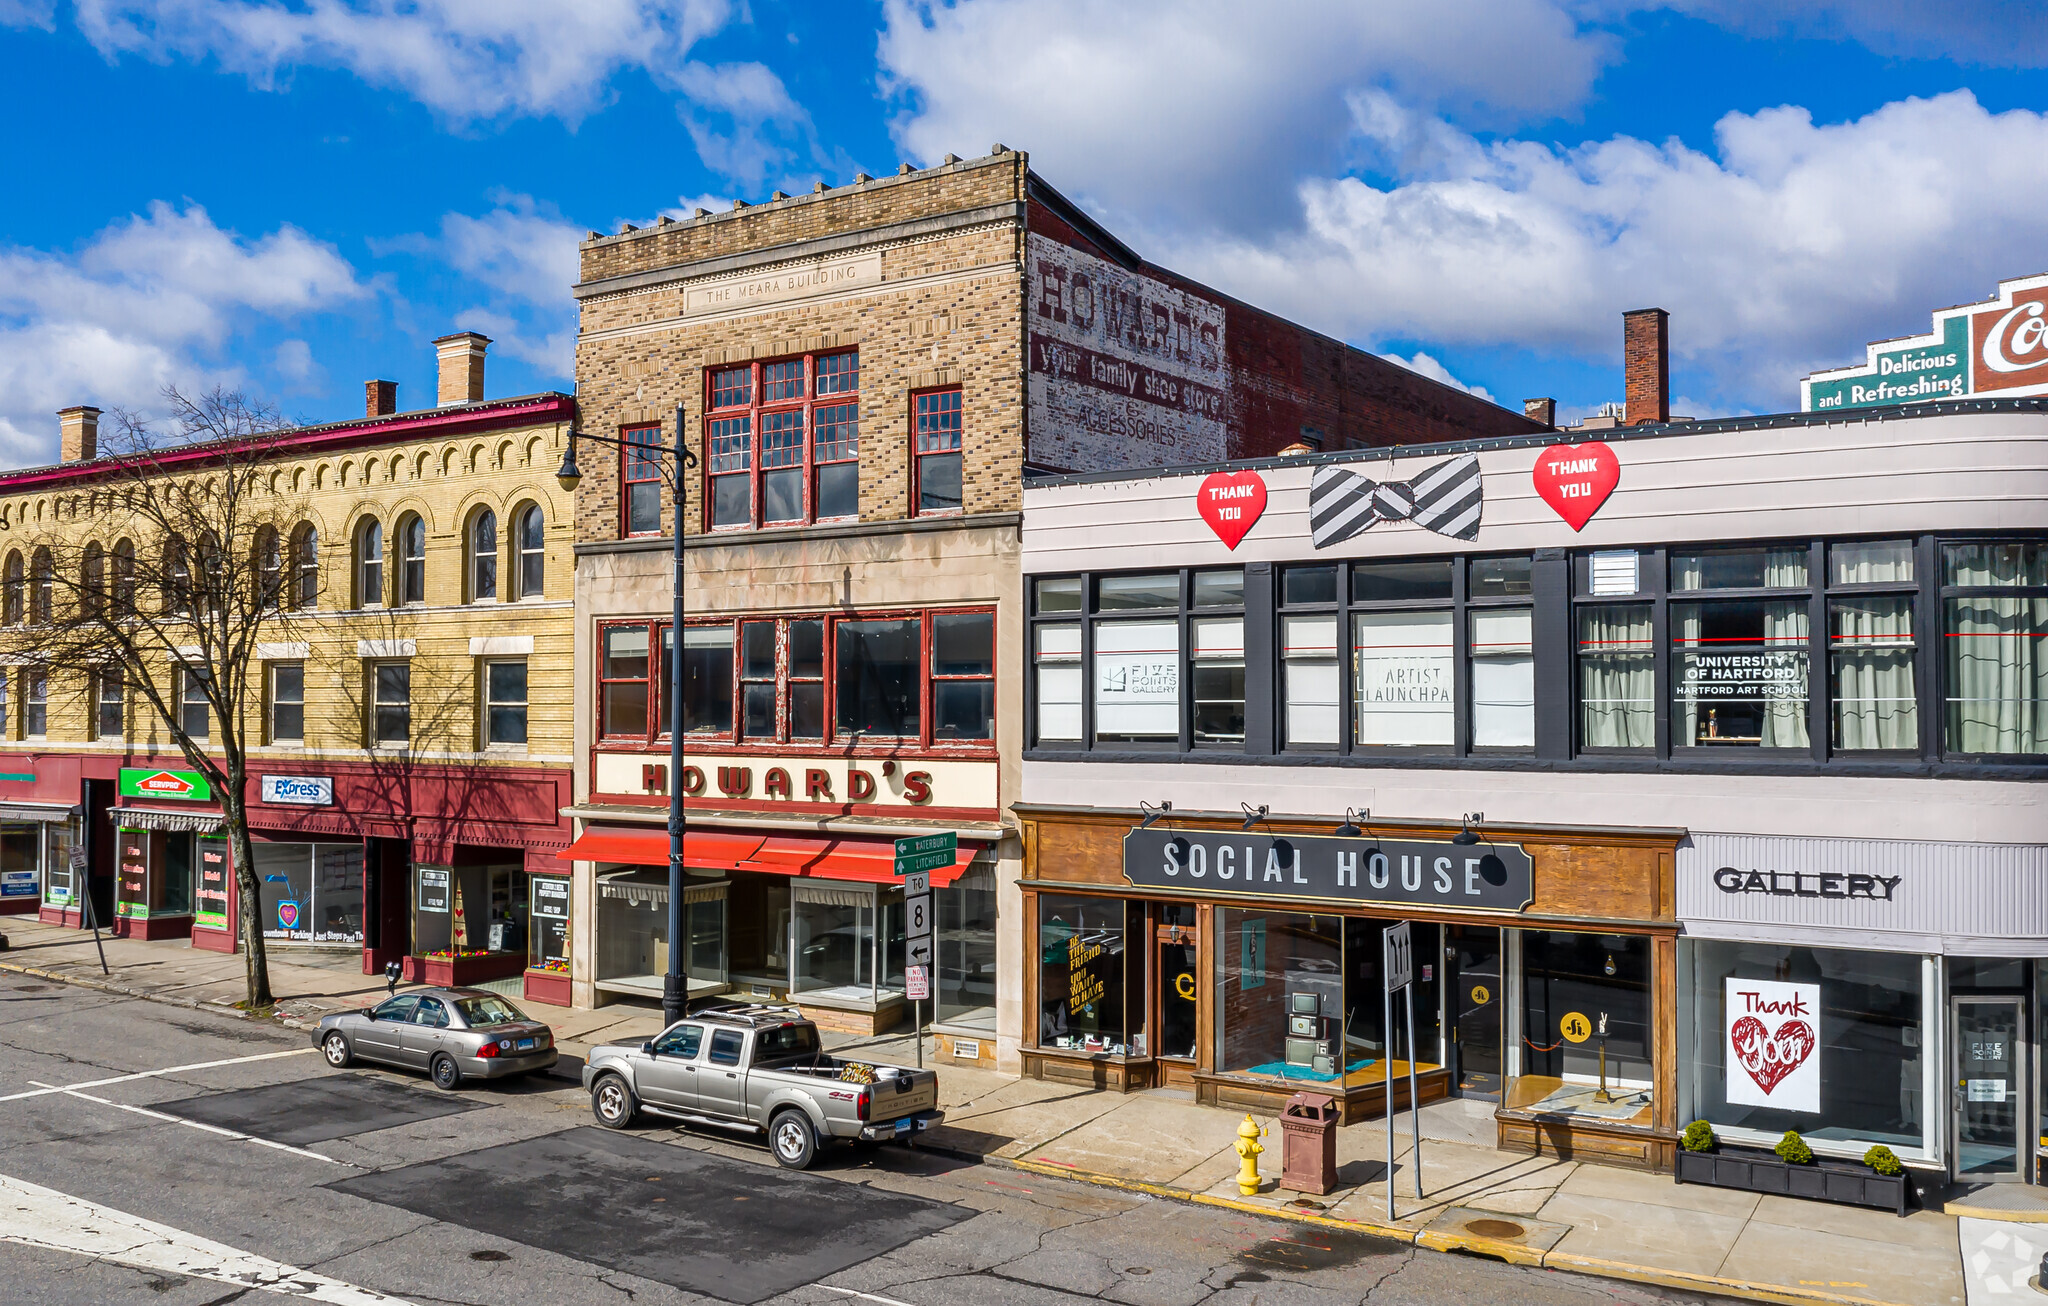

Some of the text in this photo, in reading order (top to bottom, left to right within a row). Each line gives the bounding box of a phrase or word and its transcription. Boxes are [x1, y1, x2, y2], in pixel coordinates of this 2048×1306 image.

[707, 266, 856, 303] THE MEARA BUILDING
[1880, 351, 1957, 377] Delicious
[1039, 342, 1222, 415] your family shoe store
[1818, 373, 1964, 408] and Refreshing
[1078, 405, 1177, 448] ACCESSORIES
[1547, 457, 1598, 475] THANK
[1208, 484, 1254, 499] THANK
[1558, 481, 1592, 499] YOU
[1217, 506, 1242, 521] YOU
[1695, 656, 1785, 668] UNIVERSITY
[1131, 676, 1177, 686] POINTS
[1687, 668, 1796, 680] OF HARTFORD
[1131, 685, 1177, 694] GALLERY
[1676, 686, 1806, 696] HARTFORD ART SCHOOL
[274, 779, 320, 798] Express
[641, 760, 932, 803] HOWARD'S
[915, 836, 948, 851] WATERBURY
[915, 853, 948, 869] LITCHFIELD
[1163, 841, 1482, 895] SOCIAL HOUSE
[911, 877, 924, 890] TO
[1713, 866, 1902, 901] GALLERY
[914, 904, 923, 928] 8
[290, 930, 314, 942] Parking
[315, 931, 327, 941] Just
[327, 931, 343, 942] Steps
[343, 933, 356, 943] Past
[1069, 934, 1080, 949] BE
[1069, 942, 1086, 960] THE
[1070, 944, 1101, 971] FRIEND
[1069, 974, 1095, 997] WANT
[1070, 967, 1087, 986] YOU
[1069, 995, 1080, 1009] TO
[1081, 980, 1104, 1003] HAVE
[1736, 991, 1810, 1017] Thank
[1972, 1042, 2002, 1050] FIVE
